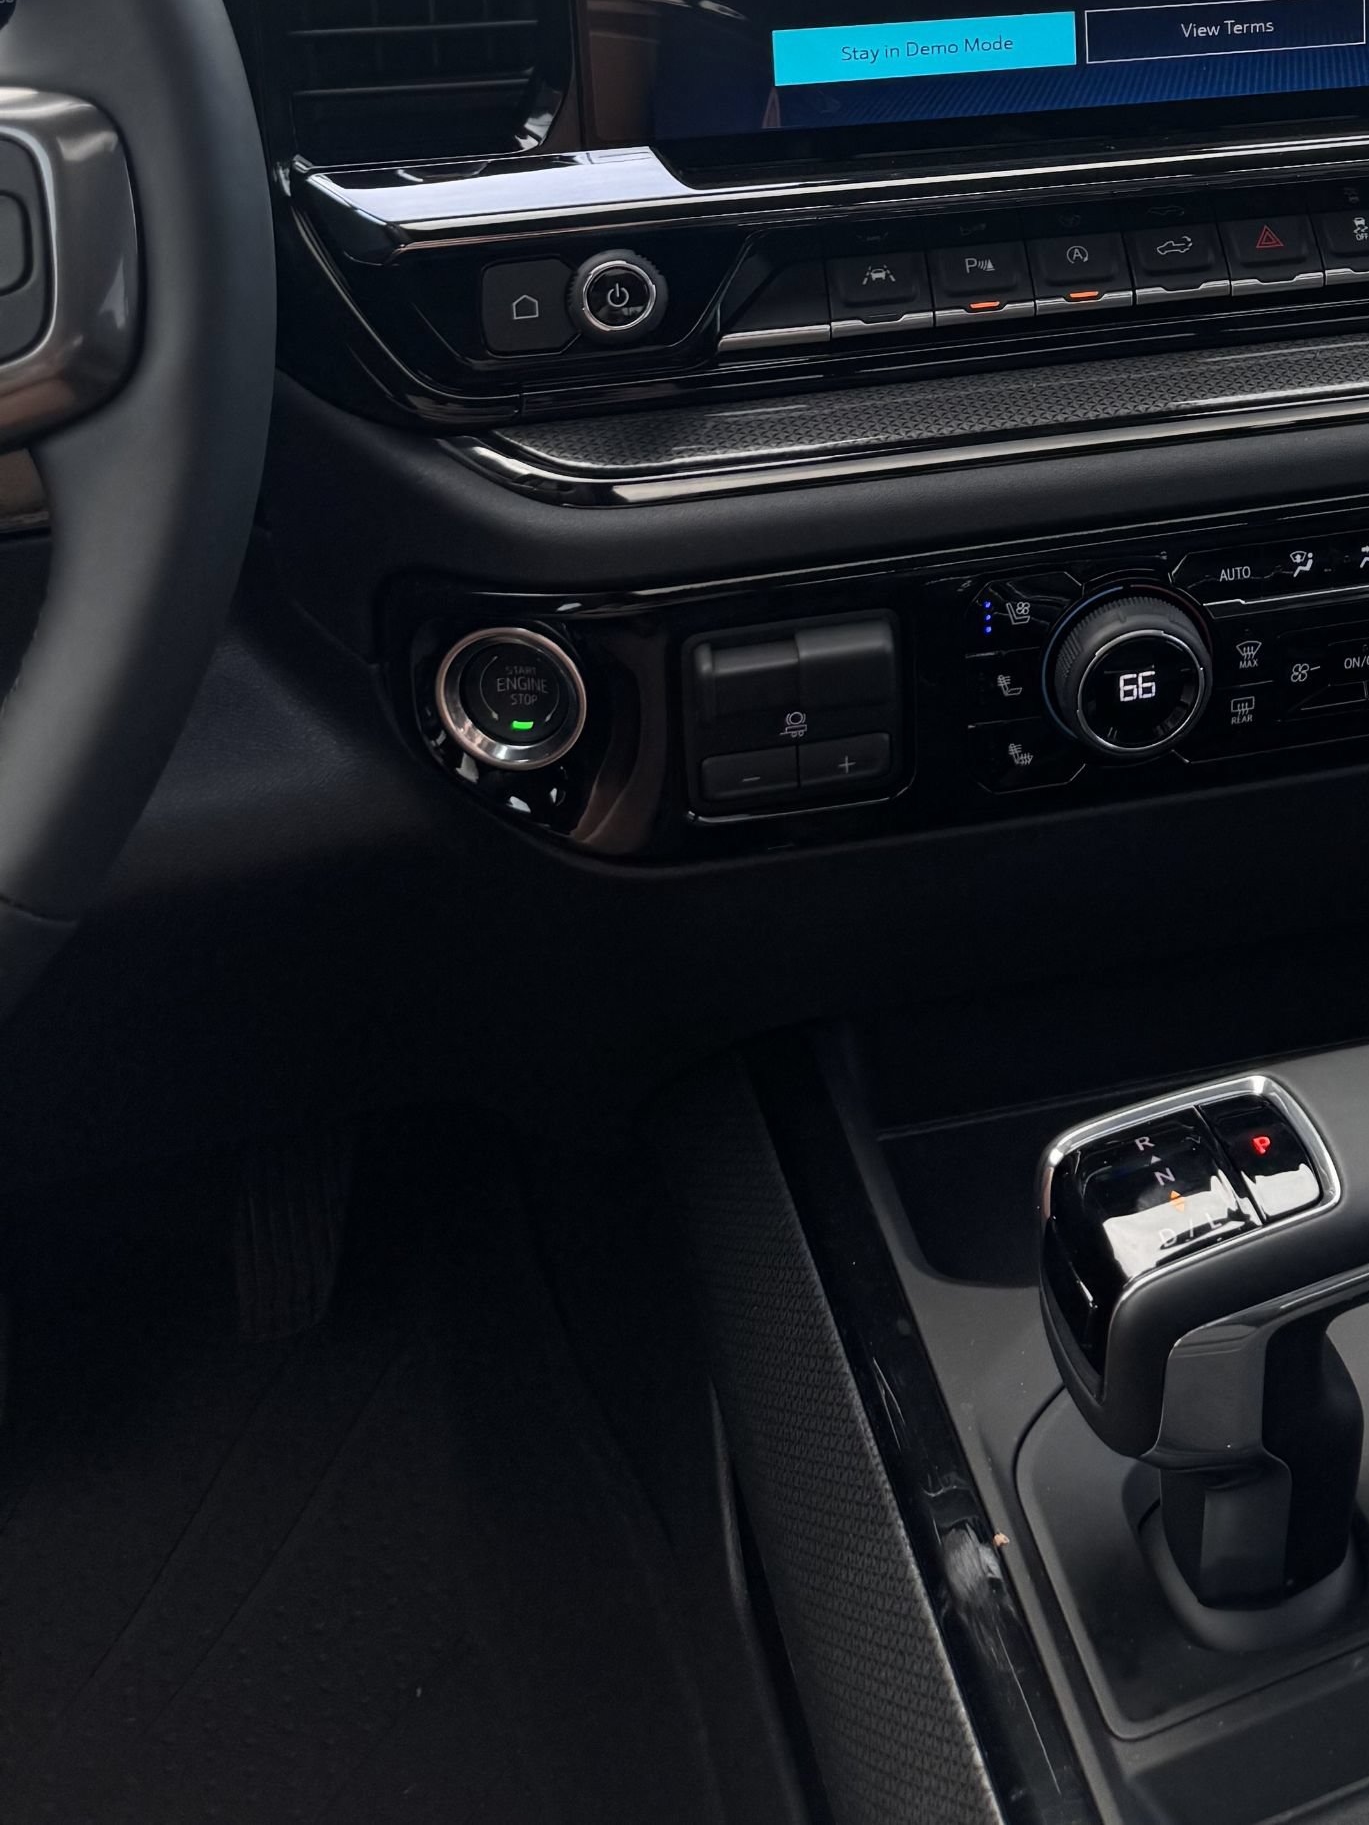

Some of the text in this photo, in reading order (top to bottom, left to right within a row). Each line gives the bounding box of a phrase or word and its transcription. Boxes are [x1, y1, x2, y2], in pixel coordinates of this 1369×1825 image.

[1181, 18, 1275, 39] View Terms
[840, 34, 1014, 65] Stay in Demo Mode
[1219, 565, 1252, 582] AUTO
[504, 665, 537, 675] START
[1239, 657, 1259, 669] MAX
[496, 676, 550, 694] ENGINE
[1118, 670, 1156, 703] 66
[510, 693, 539, 706] STOP
[1231, 713, 1254, 725] REAR
[1134, 1135, 1156, 1152] R
[1252, 1136, 1272, 1155] P
[1153, 1167, 1177, 1186] N
